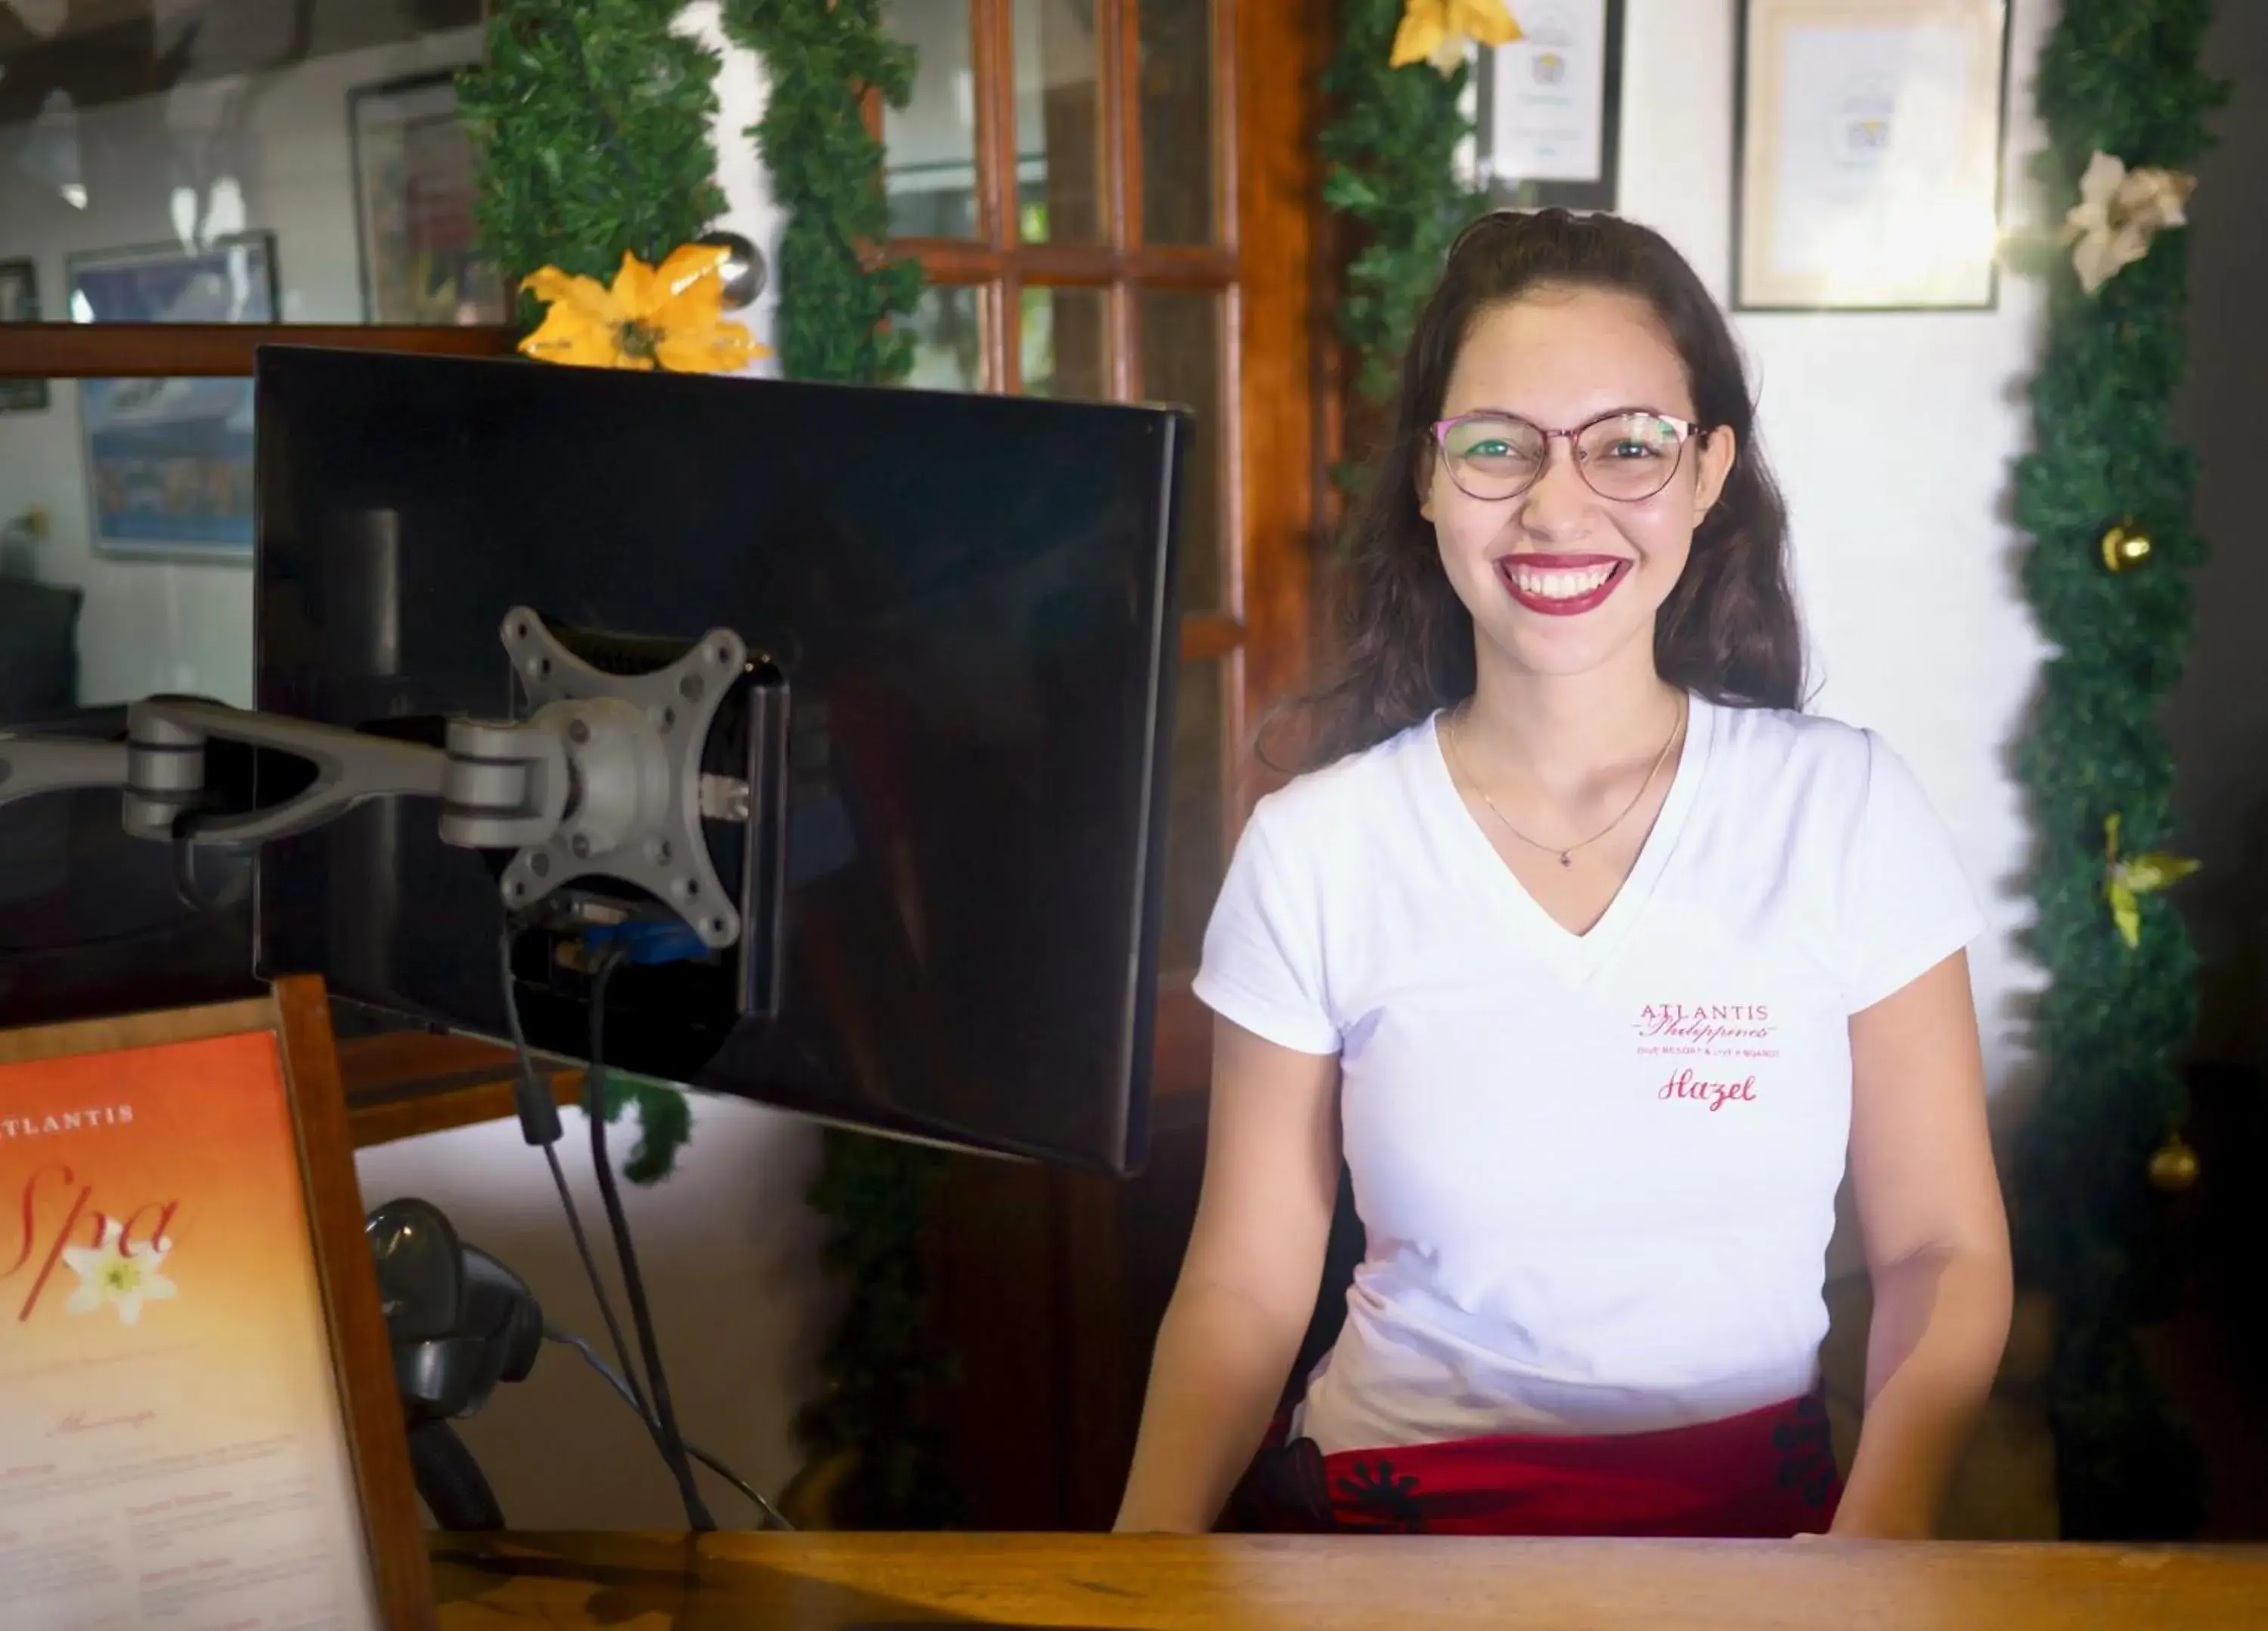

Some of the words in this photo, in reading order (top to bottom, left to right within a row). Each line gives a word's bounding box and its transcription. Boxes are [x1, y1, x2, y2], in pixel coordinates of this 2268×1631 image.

[1637, 1014, 1770, 1044] Philippines
[1641, 1004, 1769, 1020] ATLANTIS
[1658, 1067, 1757, 1112] Hazel
[0, 1104, 134, 1138] TLANTIS
[0, 1165, 179, 1322] Spa
